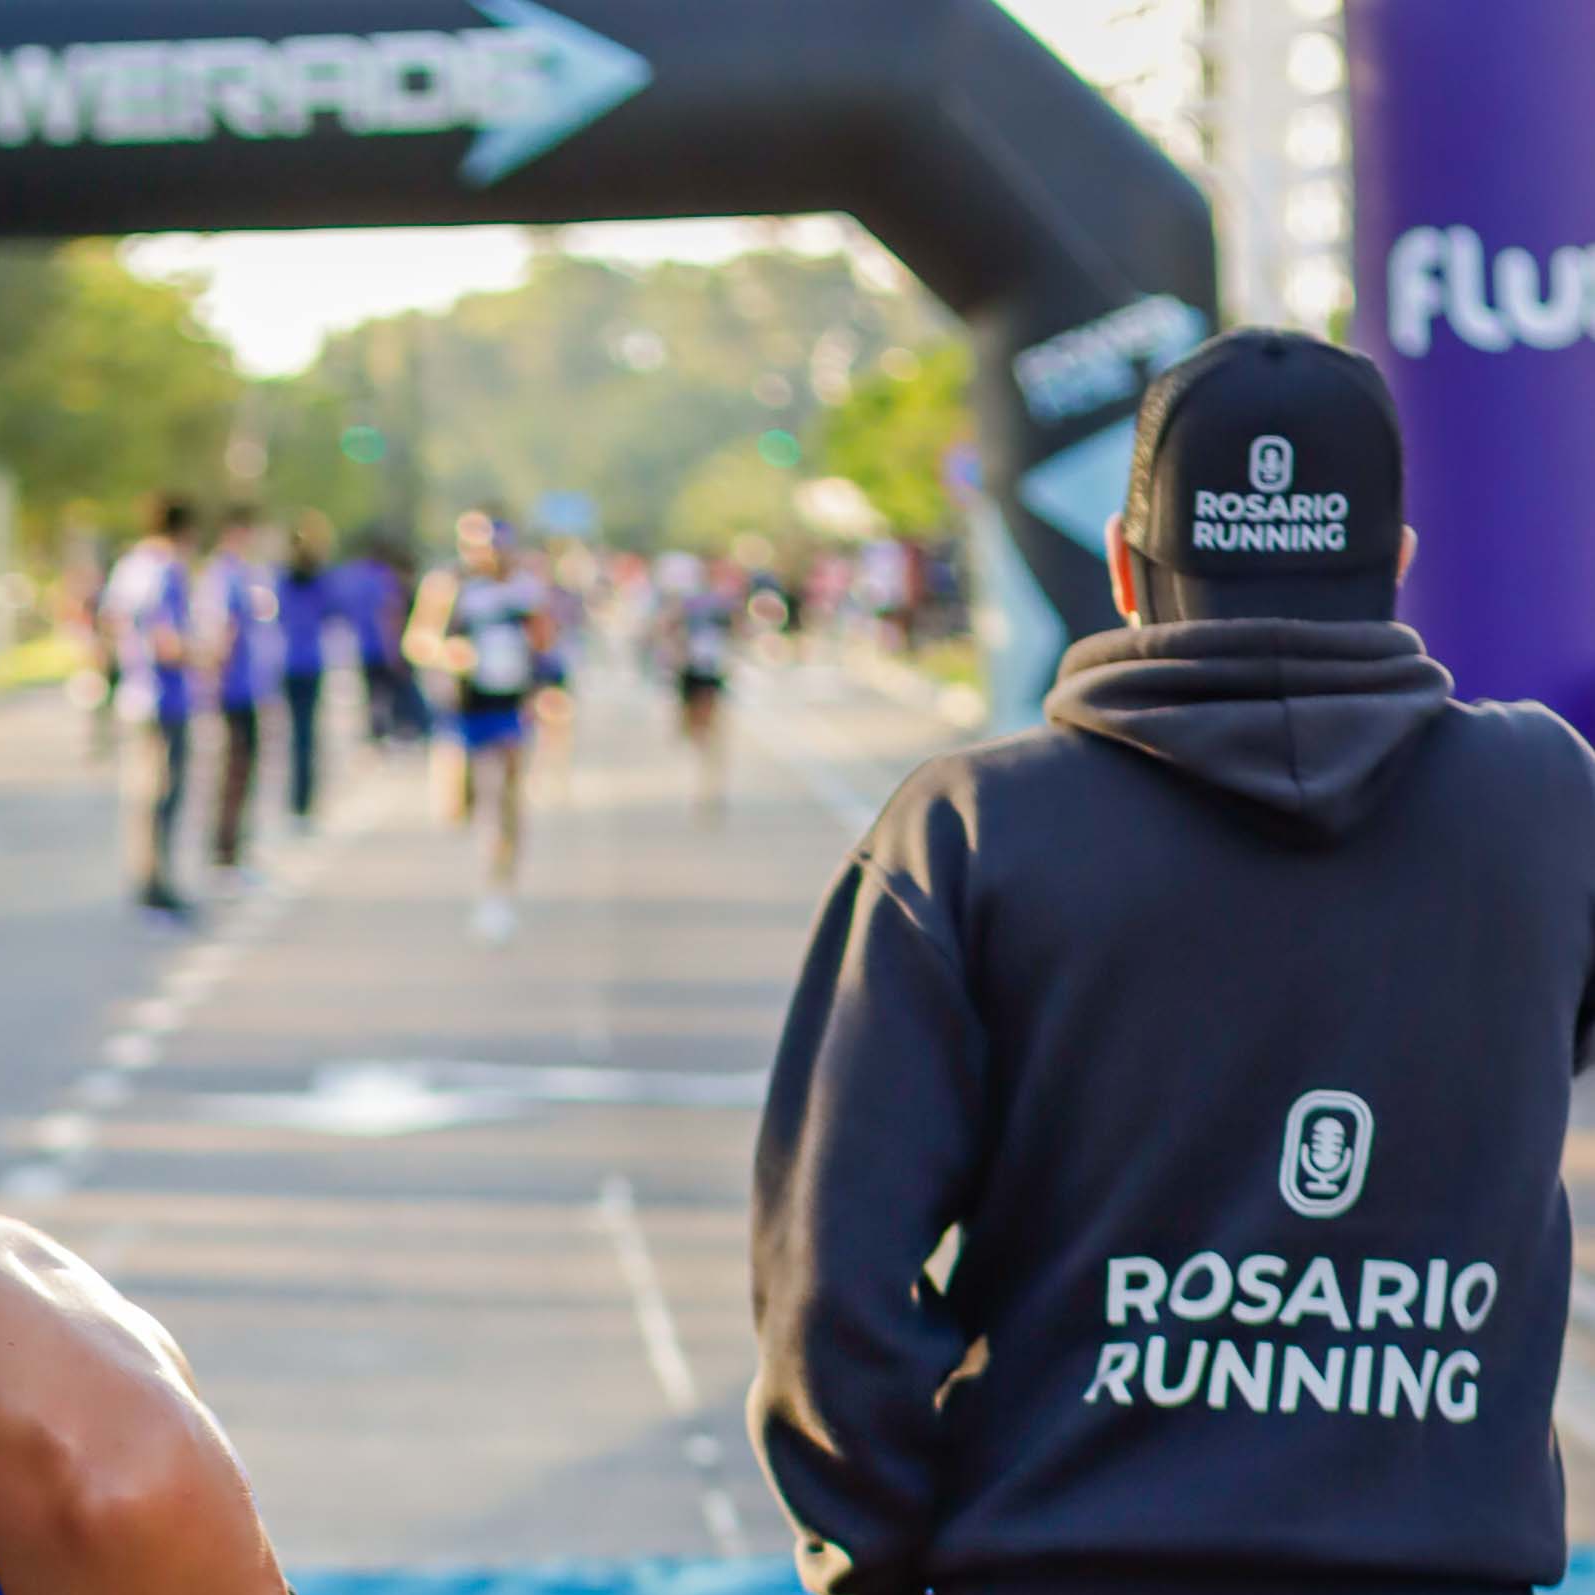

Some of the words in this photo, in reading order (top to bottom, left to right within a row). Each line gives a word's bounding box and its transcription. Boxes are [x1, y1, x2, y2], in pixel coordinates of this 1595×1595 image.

[1195, 490, 1349, 521] ROSARIO
[1193, 521, 1346, 551] RUNNING
[1106, 1250, 1498, 1333] ROSARIO
[1083, 1335, 1481, 1423] RUNNING
